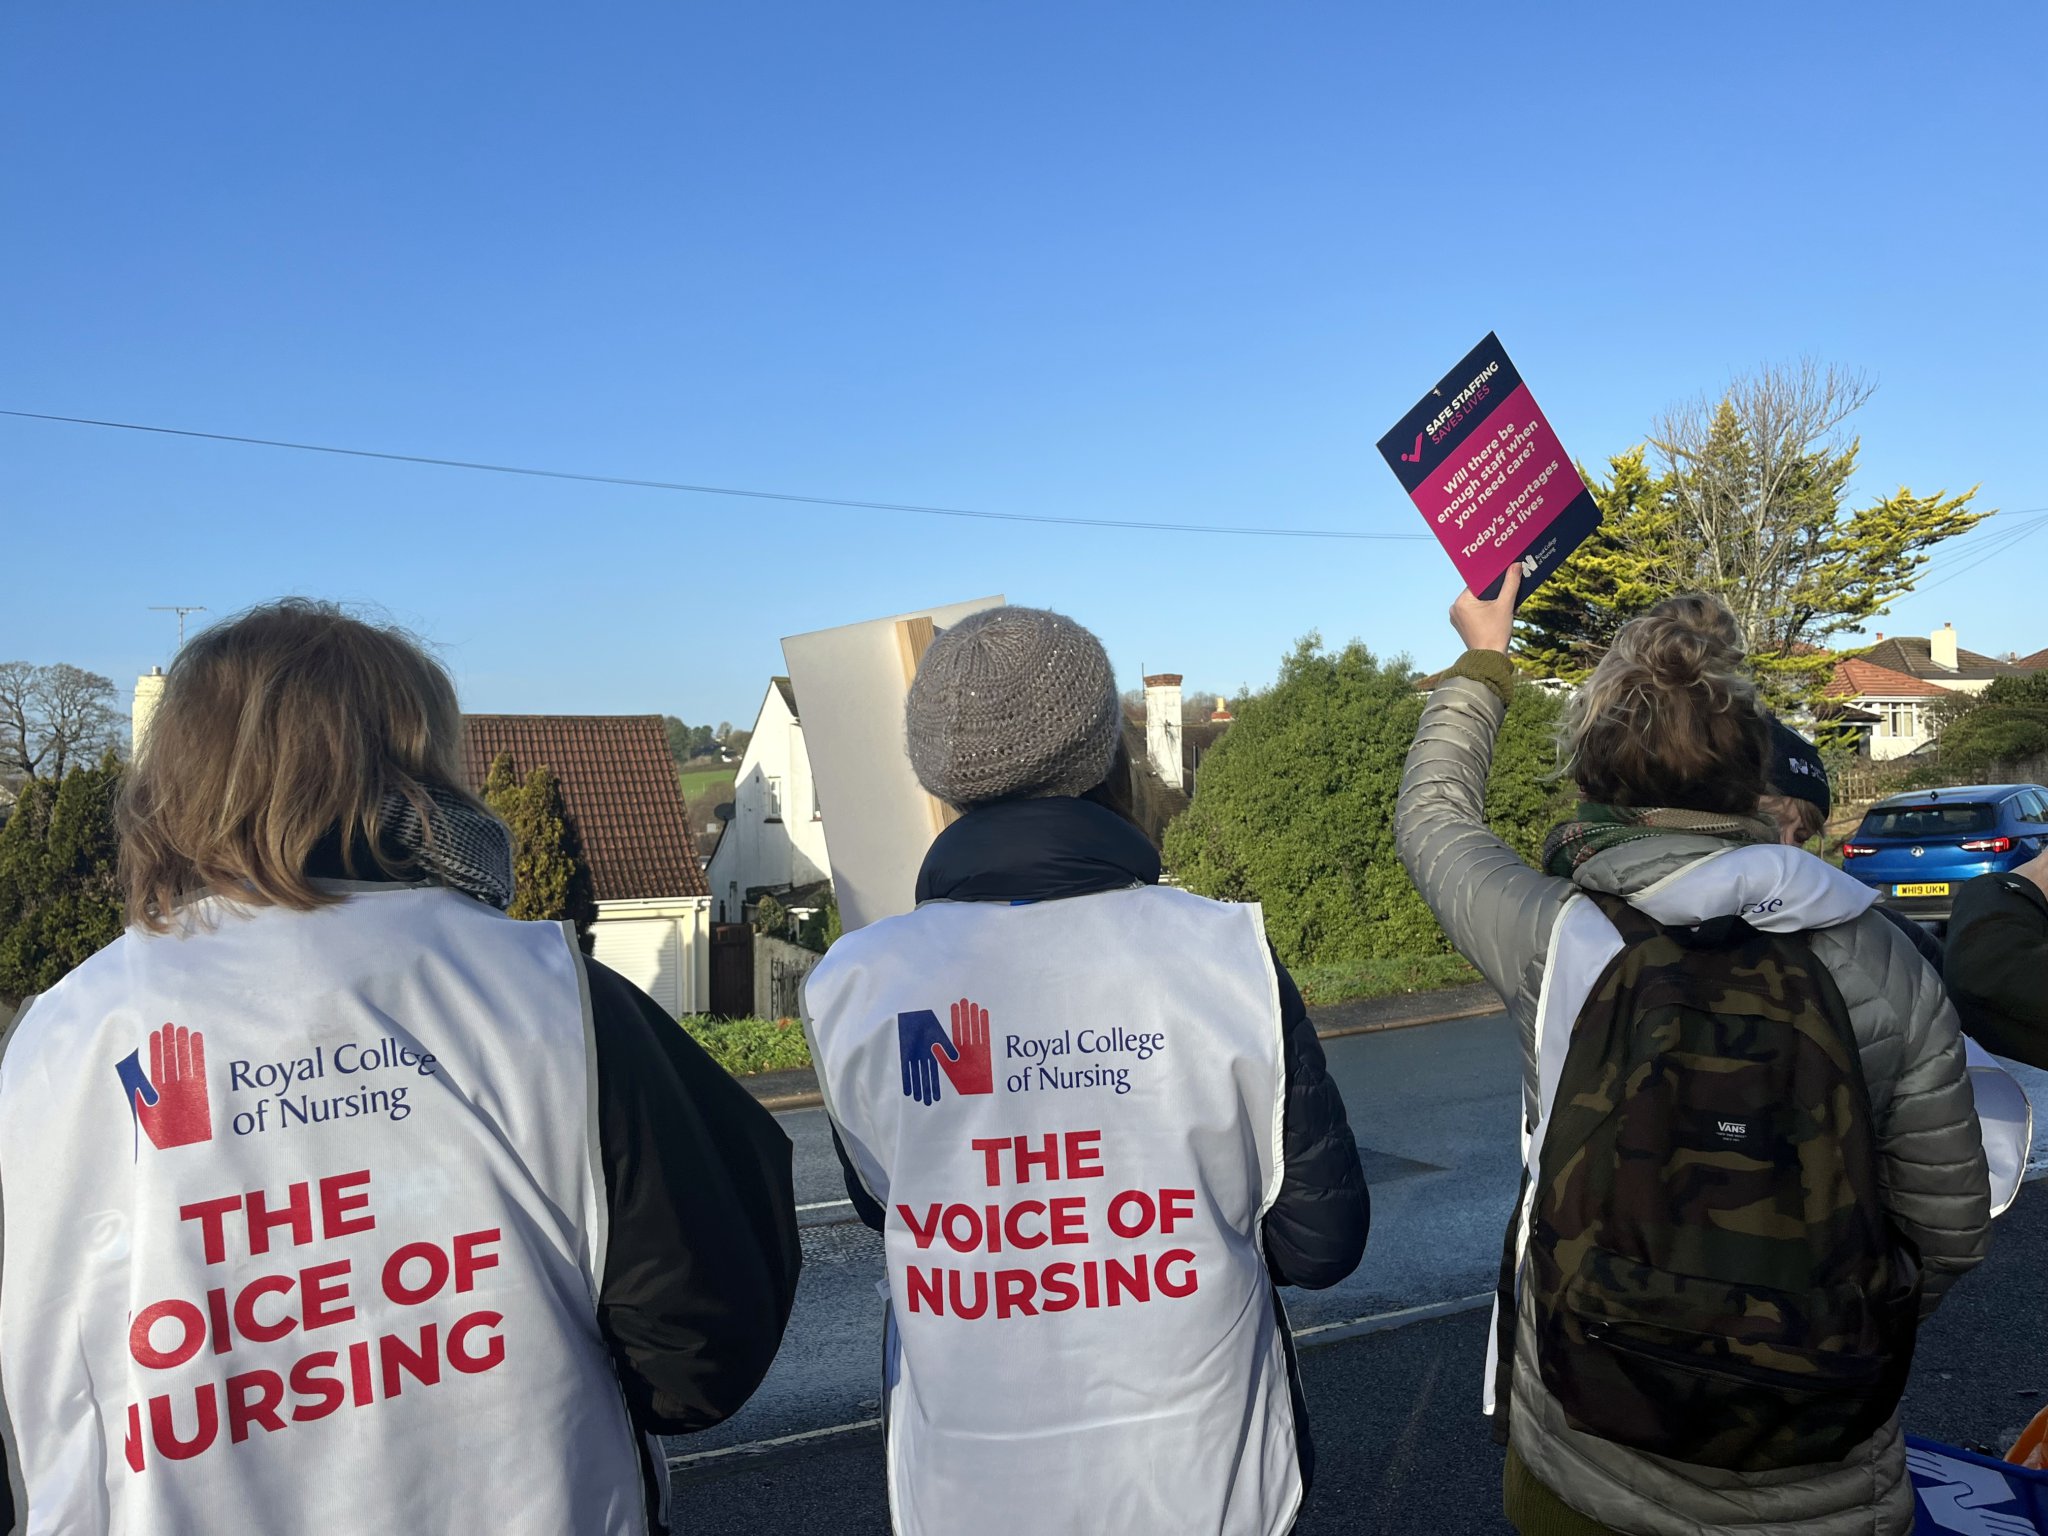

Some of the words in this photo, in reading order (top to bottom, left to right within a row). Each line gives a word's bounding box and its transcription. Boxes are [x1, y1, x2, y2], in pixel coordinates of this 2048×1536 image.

[1426, 406, 1453, 435] SAFE
[1452, 361, 1499, 410] STAFFING
[1432, 411, 1463, 444] SAVES
[1463, 385, 1490, 414] LIVES
[1437, 480, 1481, 523] enough
[1480, 449, 1507, 480] staff
[1506, 420, 1539, 453] when
[1443, 467, 1469, 494] Will
[1468, 439, 1499, 471] there
[1498, 423, 1515, 440] be
[1454, 502, 1478, 529] you
[1477, 471, 1507, 504] need
[1506, 441, 1535, 475] care?
[1462, 515, 1505, 558] Today's
[1505, 460, 1559, 517] shortages
[1494, 521, 1519, 547] cost
[1517, 495, 1544, 523] lives
[1902, 886, 1923, 894] WH19
[229, 1046, 324, 1097] Royal
[334, 1038, 437, 1076] Collee
[1005, 1030, 1071, 1066] Royal
[1077, 1027, 1165, 1060] College
[1007, 1066, 1032, 1092] of
[1039, 1063, 1132, 1094] Nursing
[232, 1103, 269, 1136] of
[281, 1085, 412, 1129] Nursing
[1717, 1121, 1746, 1133] VANS
[972, 1130, 1104, 1187] THE
[179, 1169, 376, 1265] THE
[896, 1196, 1089, 1253] VOICE
[1107, 1189, 1195, 1239] OF
[128, 1258, 356, 1370] OICE
[381, 1228, 501, 1306] OF
[906, 1248, 1198, 1320] NURSING
